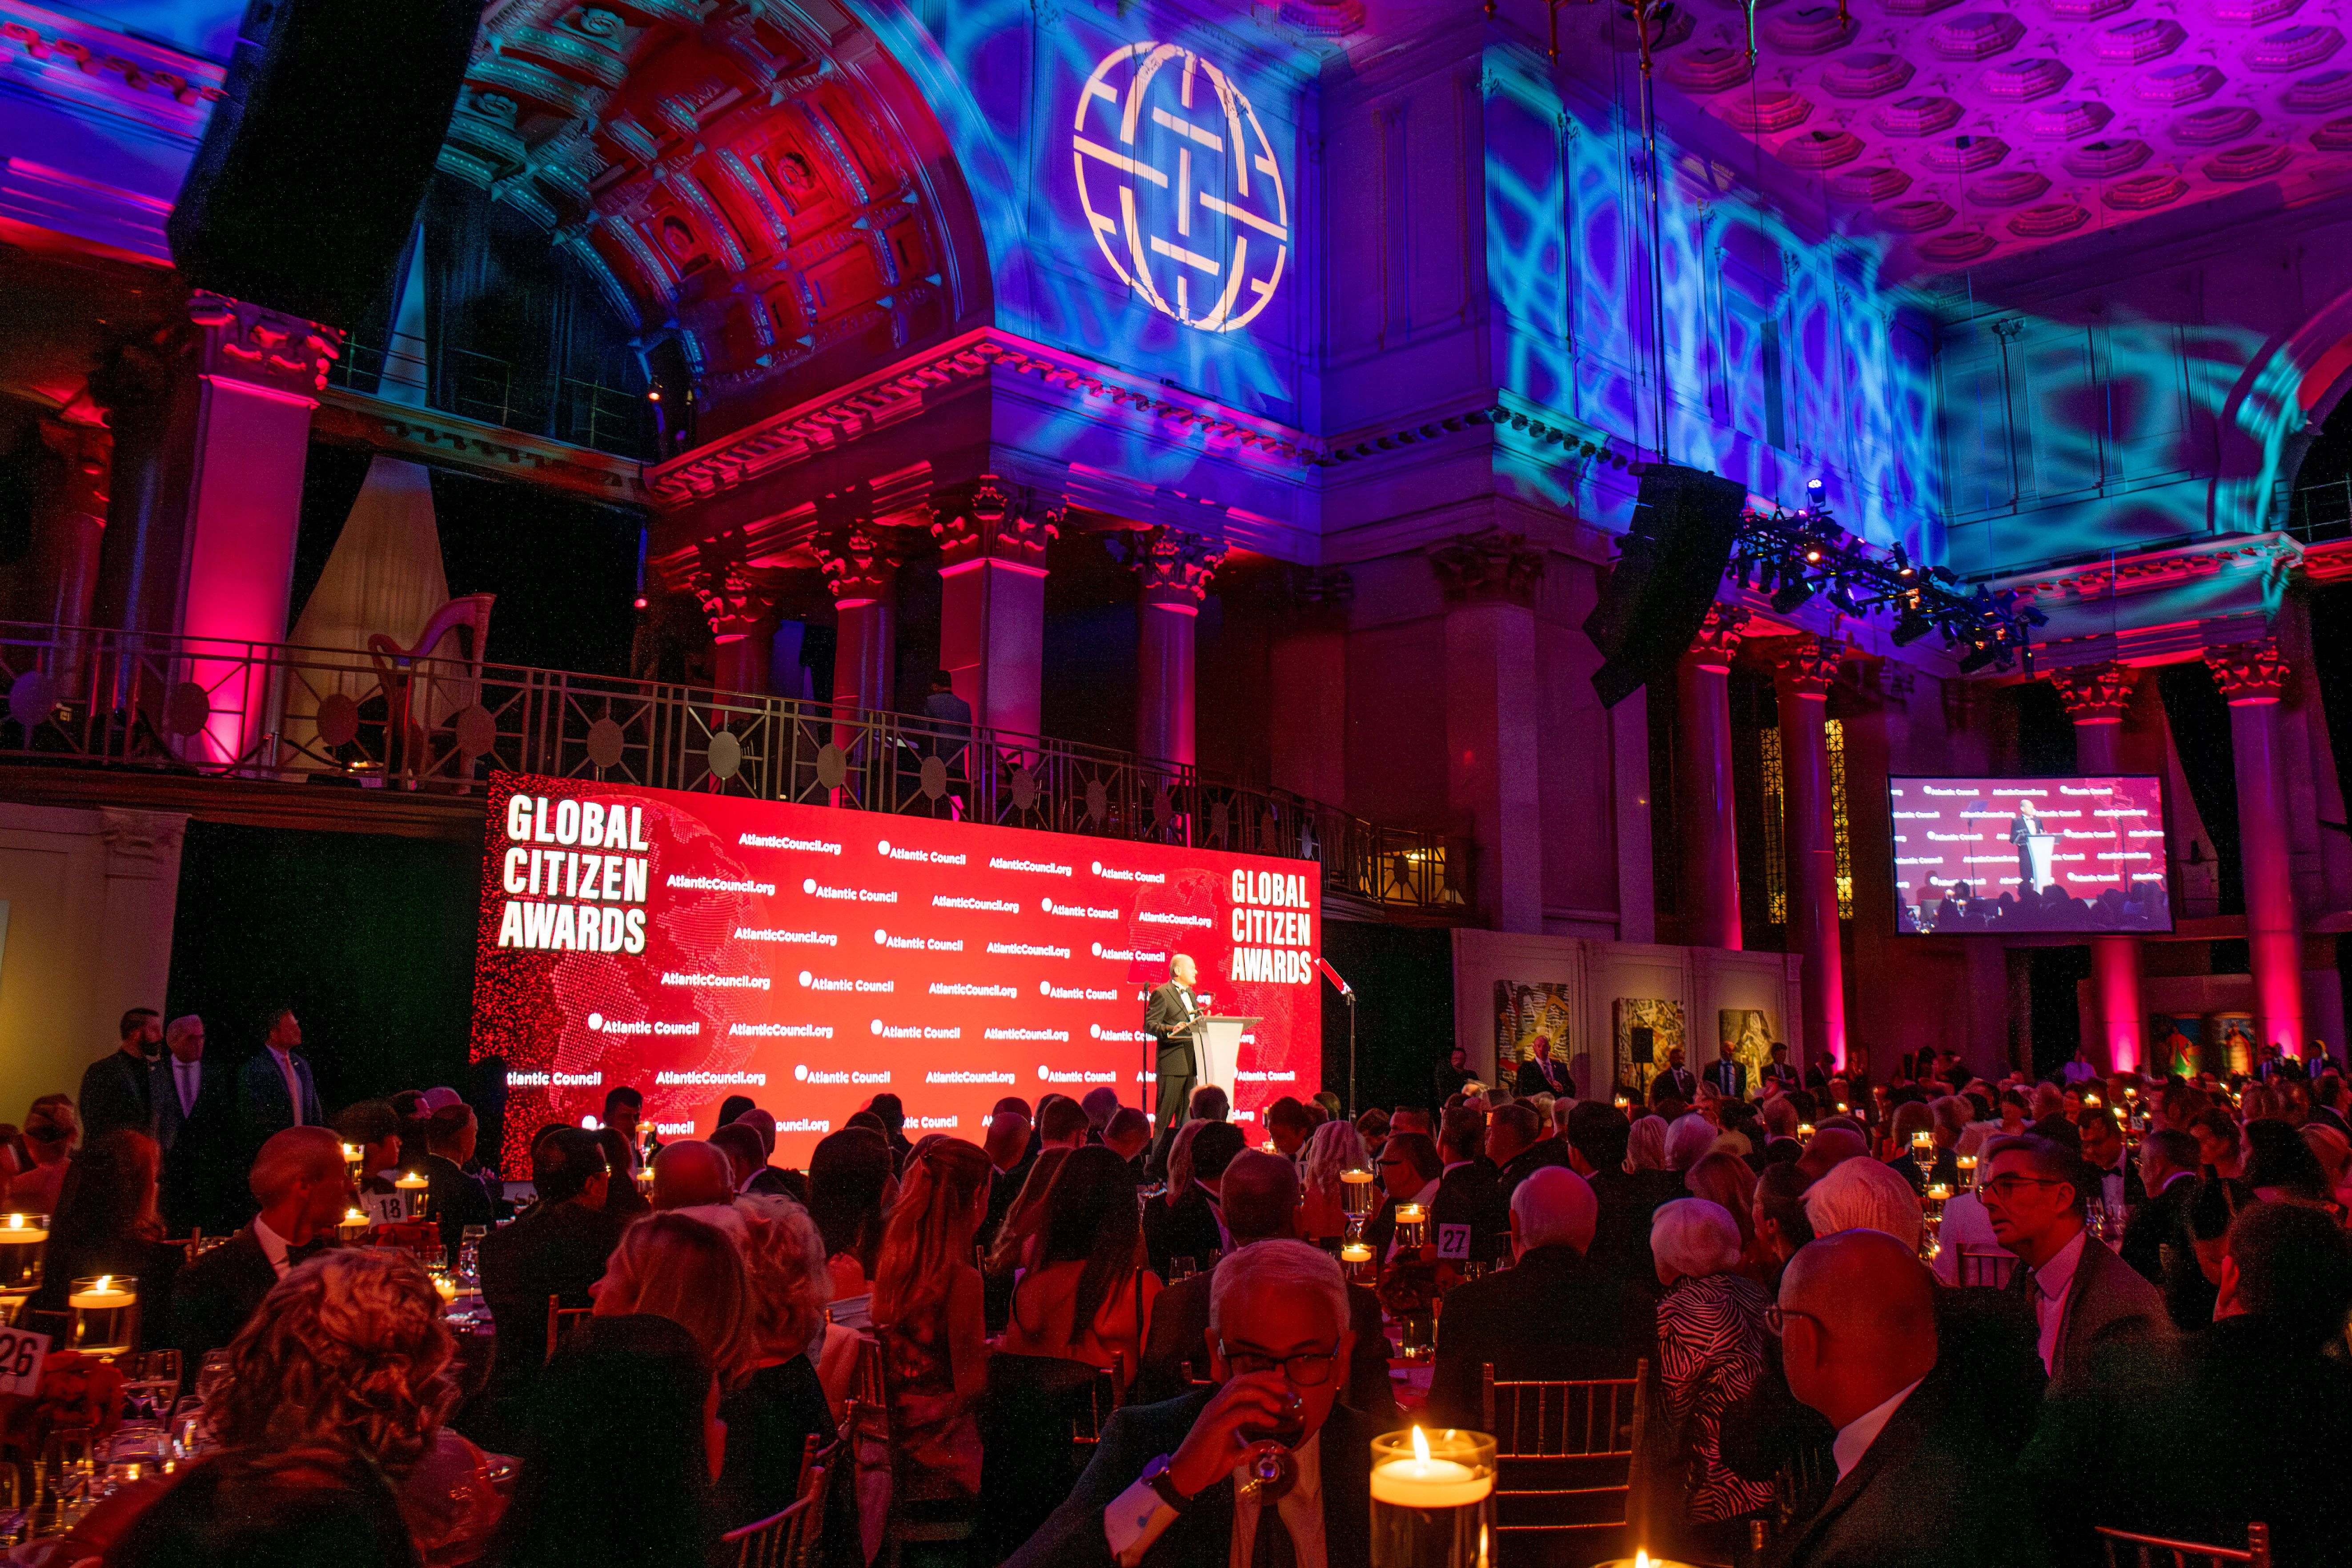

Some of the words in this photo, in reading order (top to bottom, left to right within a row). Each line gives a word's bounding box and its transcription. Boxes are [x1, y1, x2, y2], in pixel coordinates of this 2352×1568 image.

[507, 794, 649, 851] GLOBAL
[739, 833, 842, 855] AtlanticCouncil.org
[890, 847, 928, 862] Atlantic
[930, 851, 966, 865] Council
[504, 846, 648, 903] CITIZEN
[989, 857, 1072, 877] AtlanticCouncil.org
[1101, 868, 1134, 881] Atlantic
[1134, 871, 1165, 883] Council
[666, 874, 775, 896] AtlanticCouncil.org
[1232, 869, 1310, 909] GLOBAL
[816, 886, 857, 900] Atlantic
[859, 889, 898, 903] Council
[931, 895, 1019, 914] AtlanticCouncil.org
[1052, 904, 1086, 917] Atlantic
[1087, 907, 1119, 919] Council
[498, 901, 646, 953] AWARDS
[1138, 911, 1212, 928] AtlanticCouncil.org
[1232, 907, 1310, 946] CITIZEN
[734, 927, 837, 946] AtlanticCouncil.org
[886, 936, 925, 950] Atlantic
[927, 938, 963, 951] Council
[986, 942, 1070, 959] AtlanticCouncil.org
[1101, 949, 1134, 961] Atlantic
[1135, 950, 1165, 962] Council
[1231, 947, 1311, 984] AWARDS
[661, 972, 771, 991] AtlanticCouncil.org
[811, 978, 853, 991] Atlantic
[855, 979, 894, 992] Council
[928, 982, 1017, 999] AtlanticCouncil.org
[1050, 987, 1084, 999] Atlantic
[1085, 988, 1117, 1000] Council
[602, 1020, 652, 1034] Atlantic
[654, 1021, 700, 1035] Council
[729, 1023, 833, 1039] AtlanticCouncil.org
[882, 1024, 922, 1039] Atlantic
[923, 1027, 960, 1039] Council
[984, 1028, 1069, 1042] AtlanticCouncil.org
[1100, 1030, 1133, 1041] Atlantic
[506, 1071, 550, 1086] tlantic
[553, 1071, 602, 1085] Council
[655, 1071, 766, 1086] AtlanticCouncil.org
[807, 1071, 849, 1084] Atlantic
[851, 1071, 891, 1084] Council
[925, 1071, 1015, 1085] AtlanticCouncil.org
[1048, 1069, 1083, 1083] Atlantic
[1084, 1071, 1116, 1083] Council
[1238, 1071, 1267, 1081] Atlantic
[1267, 1071, 1295, 1081] Council
[657, 1121, 694, 1135] ouncil
[775, 1118, 830, 1133] ouncil.org
[921, 1115, 958, 1129] Council
[380, 1199, 401, 1221] 18
[1443, 1230, 1466, 1253] 27
[0, 1334, 37, 1376] 26
